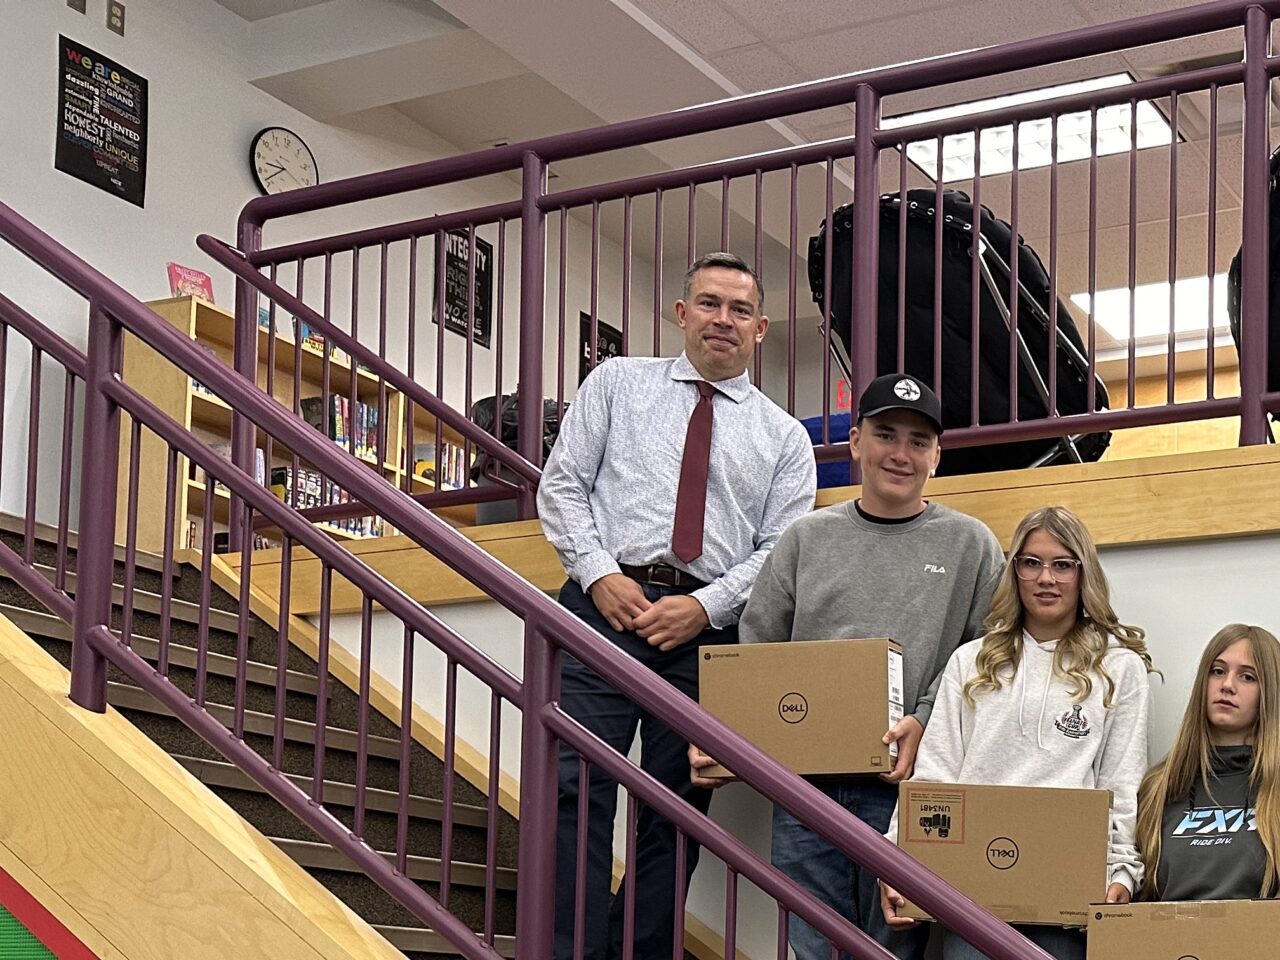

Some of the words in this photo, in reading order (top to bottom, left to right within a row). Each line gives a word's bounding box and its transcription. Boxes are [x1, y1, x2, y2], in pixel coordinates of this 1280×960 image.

[65, 48, 92, 70] we
[65, 74, 99, 95] dazzling
[106, 88, 134, 107] GRAND
[65, 109, 105, 137] HONEST
[100, 115, 140, 141] TALENTED
[64, 123, 104, 147] neighborly
[105, 142, 139, 165] UNIQUE
[445, 232, 487, 271] NTEGTY
[924, 564, 945, 573] FILA
[782, 704, 805, 712] DELL
[920, 804, 951, 812] UN3481
[990, 848, 1015, 858] DELL
